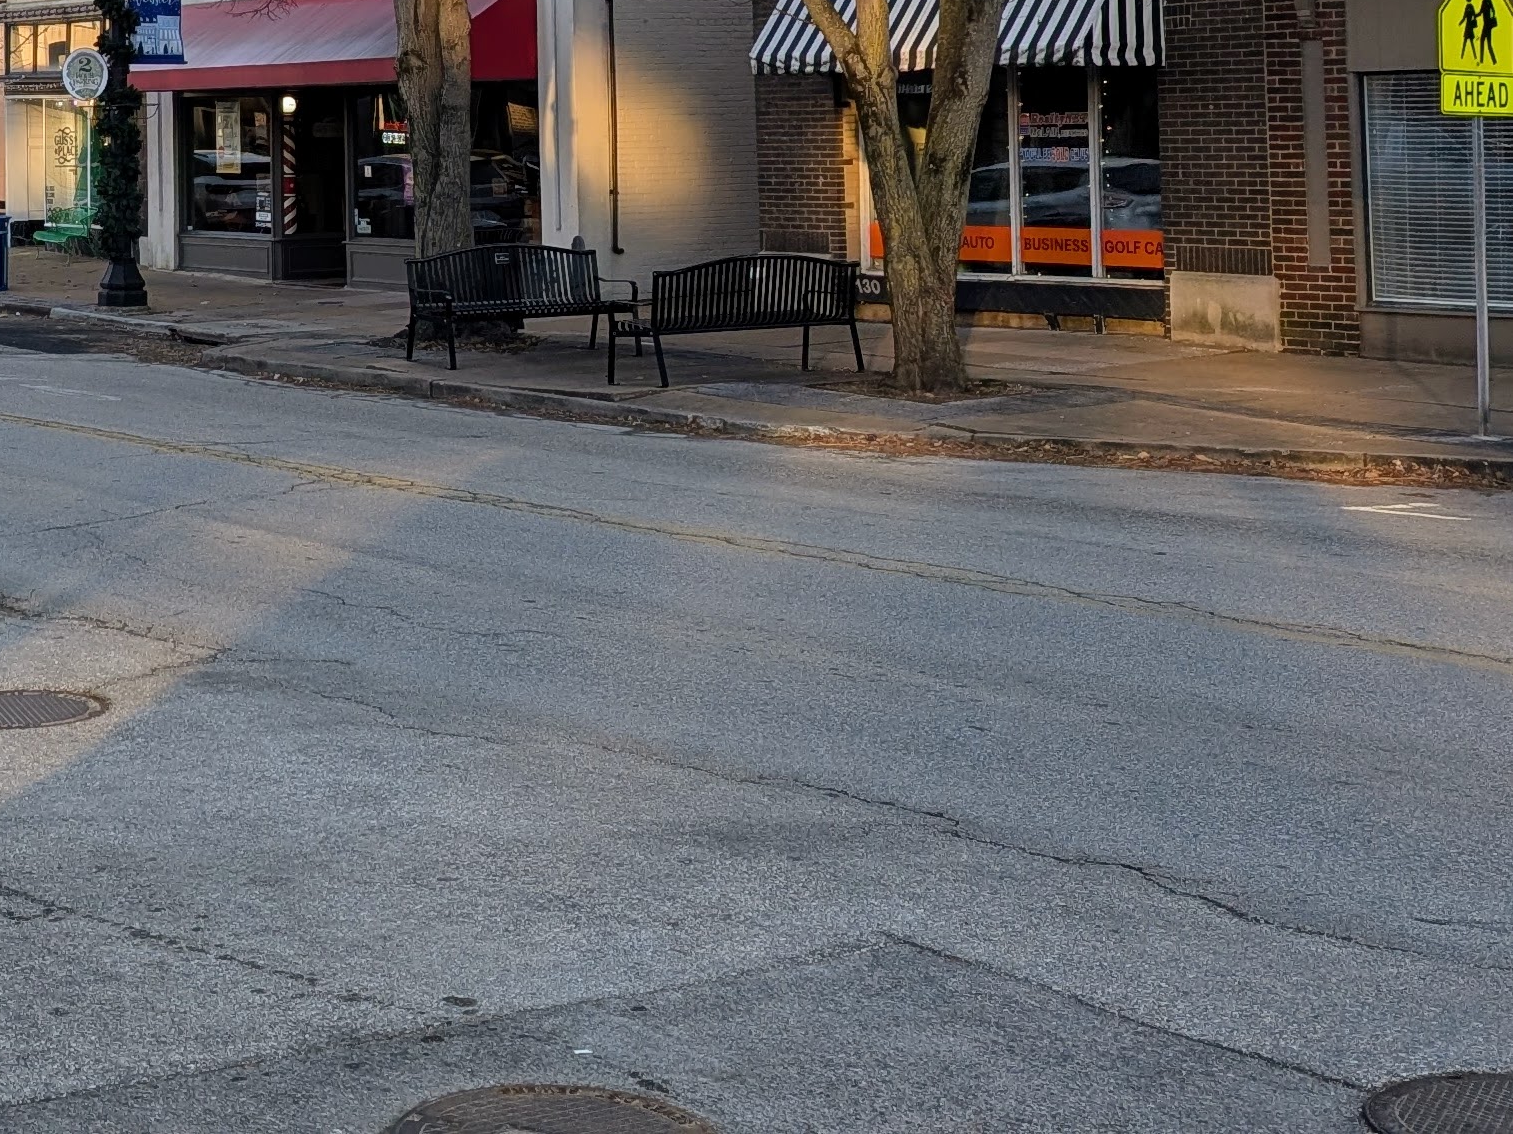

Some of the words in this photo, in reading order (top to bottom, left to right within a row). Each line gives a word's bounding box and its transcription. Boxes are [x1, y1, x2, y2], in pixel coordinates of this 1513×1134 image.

[79, 57, 92, 72] 2
[1452, 79, 1509, 108] AHEAD
[961, 236, 995, 250] AUTO
[1024, 237, 1089, 253] BUSINESS
[1104, 240, 1141, 254] GOLF
[854, 278, 881, 295] 130
